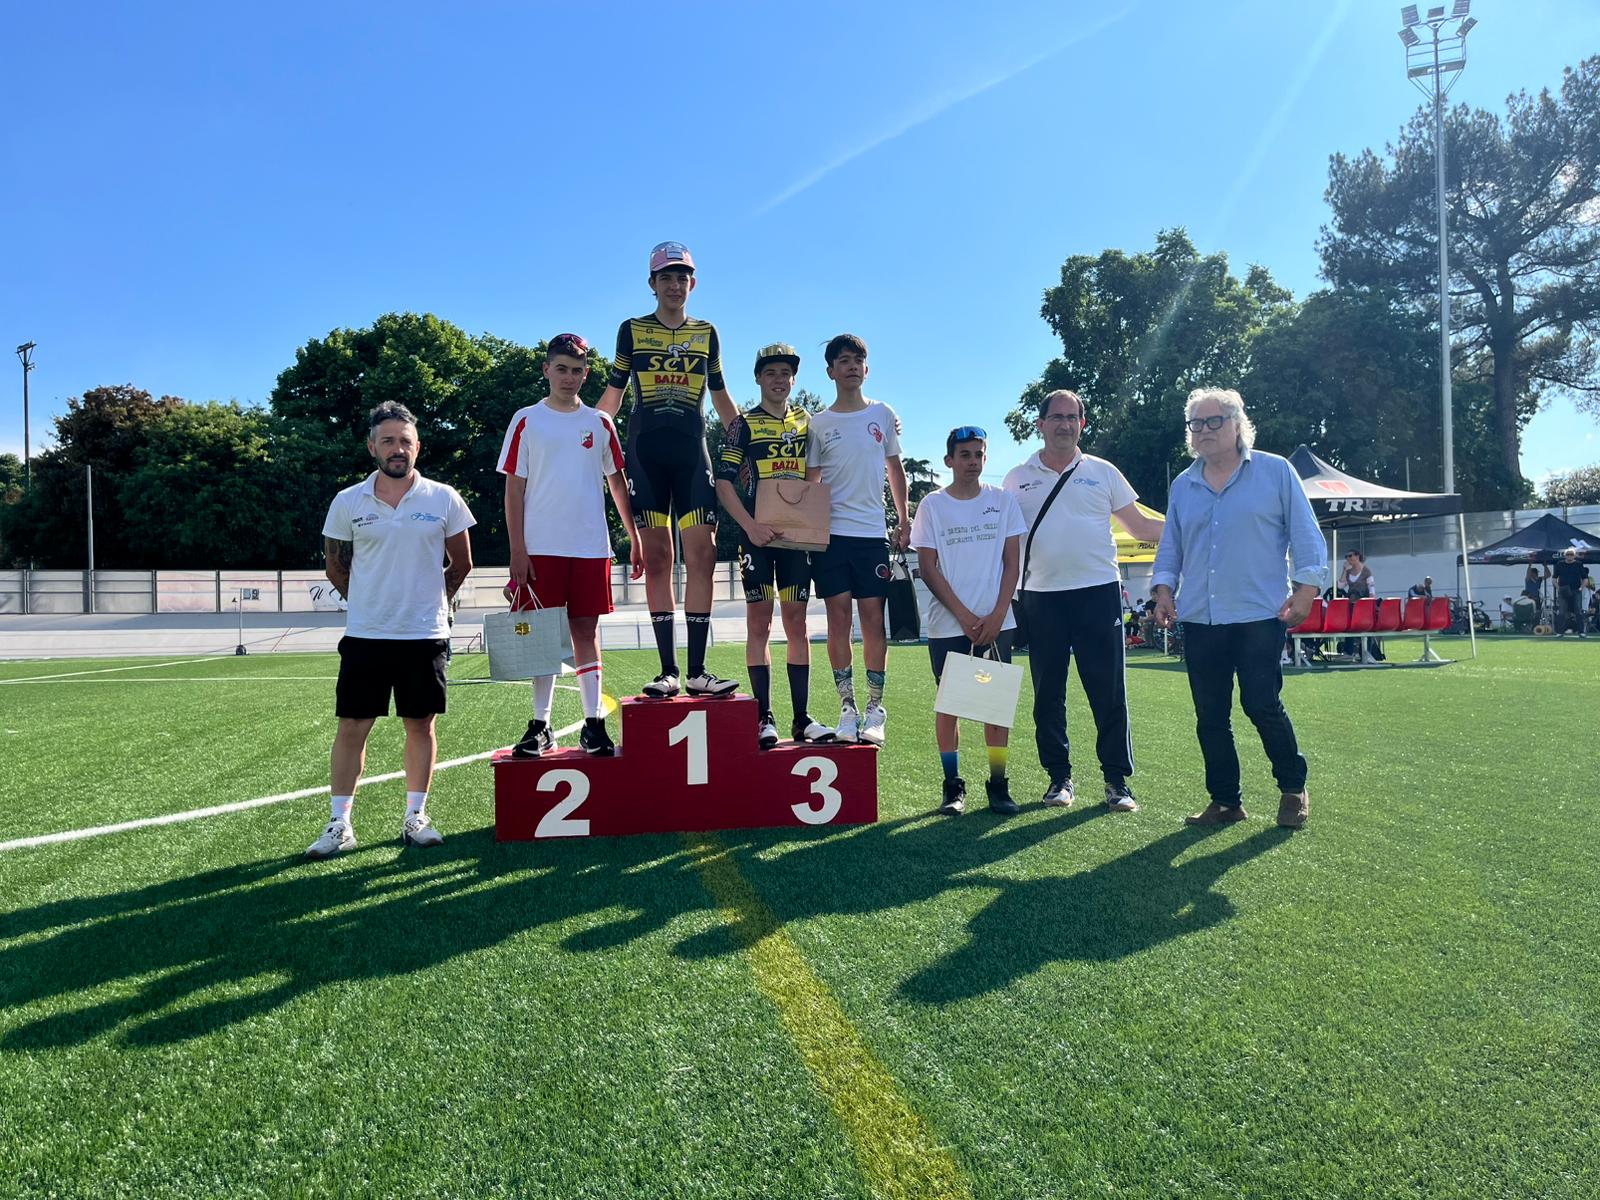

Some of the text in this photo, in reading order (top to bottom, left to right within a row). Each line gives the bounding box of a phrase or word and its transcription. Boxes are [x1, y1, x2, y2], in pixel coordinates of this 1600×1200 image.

[648, 356, 699, 373] SCV
[768, 442, 804, 459] SCV
[1326, 497, 1403, 512] TREK
[668, 710, 709, 785] 1
[534, 769, 591, 838] 2
[790, 756, 843, 825] 3
